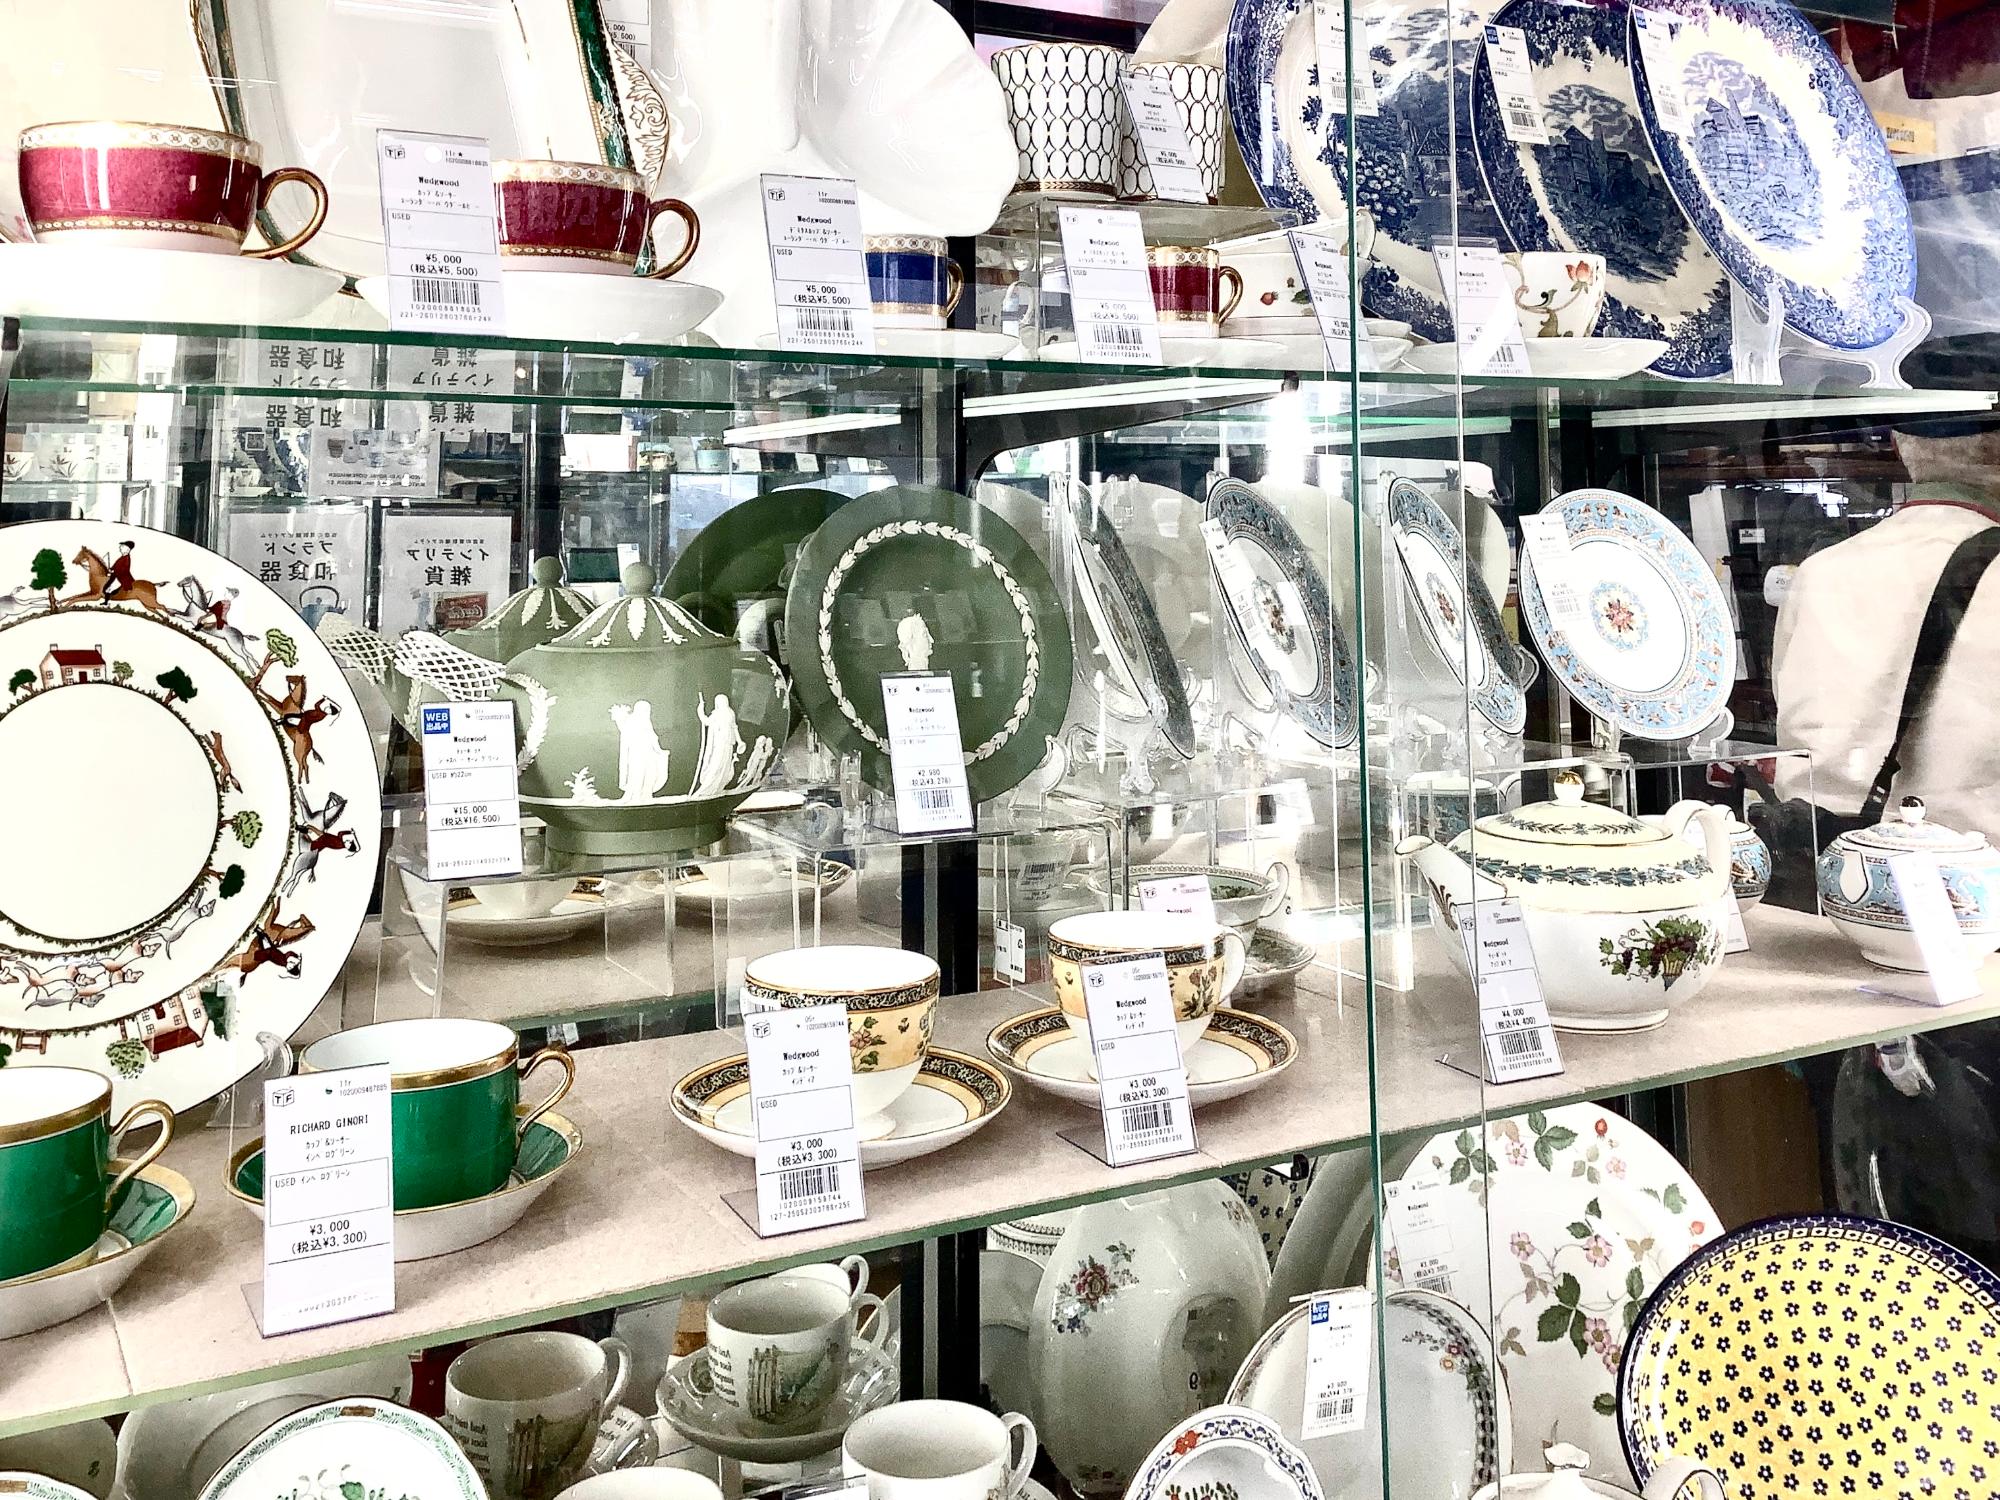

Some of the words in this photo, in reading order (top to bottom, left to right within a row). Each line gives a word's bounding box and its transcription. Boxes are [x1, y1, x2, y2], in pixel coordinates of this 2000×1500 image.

[418, 176, 460, 187] Wedgwood
[392, 212, 411, 221] USED
[797, 215, 832, 225] Wedgwood
[1089, 239, 1120, 247] Wedgwood
[776, 248, 793, 256] USED
[425, 253, 463, 265] ¥5,000
[410, 263, 479, 277] (税込¥5,500)
[806, 284, 838, 295] ¥5,000
[793, 293, 852, 305] (税込¥5,500)
[425, 712, 449, 722] WEB
[425, 722, 449, 731] 出品中
[453, 735, 487, 743] Wedgwood
[431, 772, 447, 780] USED
[453, 805, 488, 815] ¥15,000
[441, 814, 501, 827] (税込¥16,500)
[1483, 938, 1509, 948] Wedgwood
[1116, 997, 1147, 1008] Wedgwood
[1100, 1041, 1116, 1051] USED
[783, 1049, 820, 1061] Wedgwood
[1129, 1077, 1157, 1090] ¥3,000
[760, 1099, 778, 1109] USED
[290, 1120, 331, 1136] RICHARD
[335, 1114, 369, 1129] GINORI
[790, 1138, 823, 1152] ¥3,000
[777, 1148, 838, 1168] (税込¥3,300)
[275, 1177, 297, 1189] USED
[309, 1219, 351, 1236] ¥3,000
[291, 1229, 368, 1255] (税込¥3,300)
